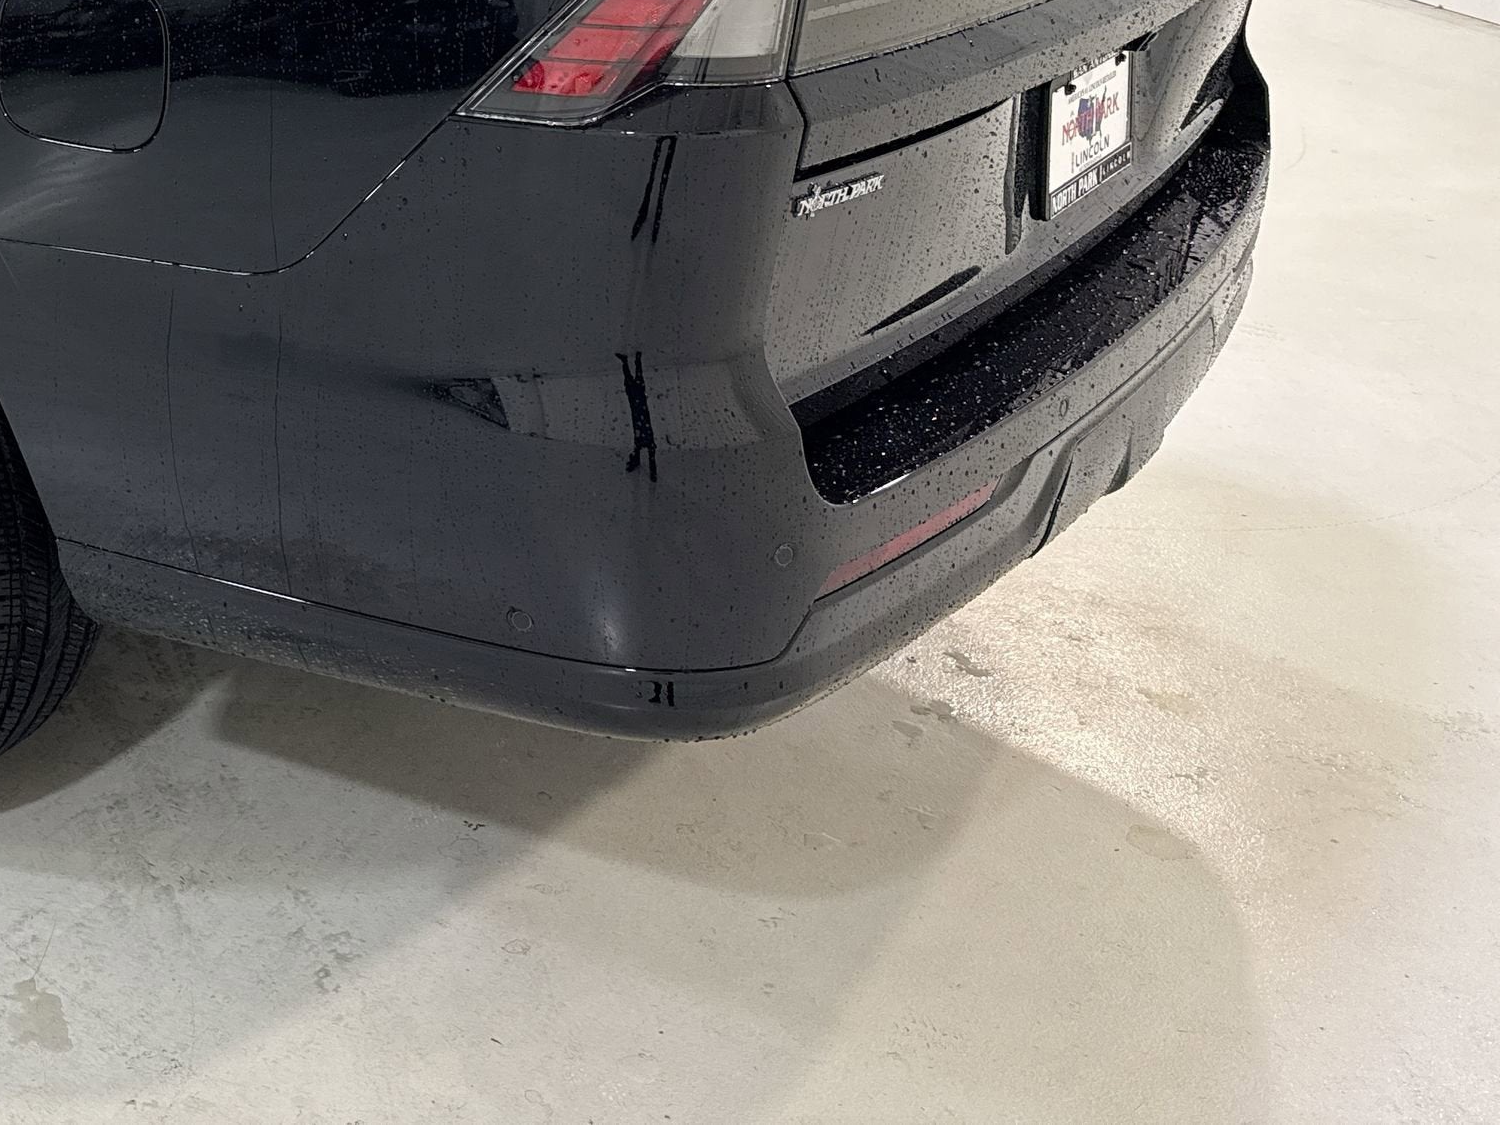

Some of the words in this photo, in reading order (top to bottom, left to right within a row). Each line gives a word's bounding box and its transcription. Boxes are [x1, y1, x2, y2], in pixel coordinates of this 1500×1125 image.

[1062, 108, 1094, 146] NORTH
[1075, 134, 1110, 168] LINCOLN
[797, 186, 850, 217] NORTH
[849, 174, 885, 201] PARK
[1052, 181, 1078, 213] NORTH
[1078, 167, 1099, 197] PARK
